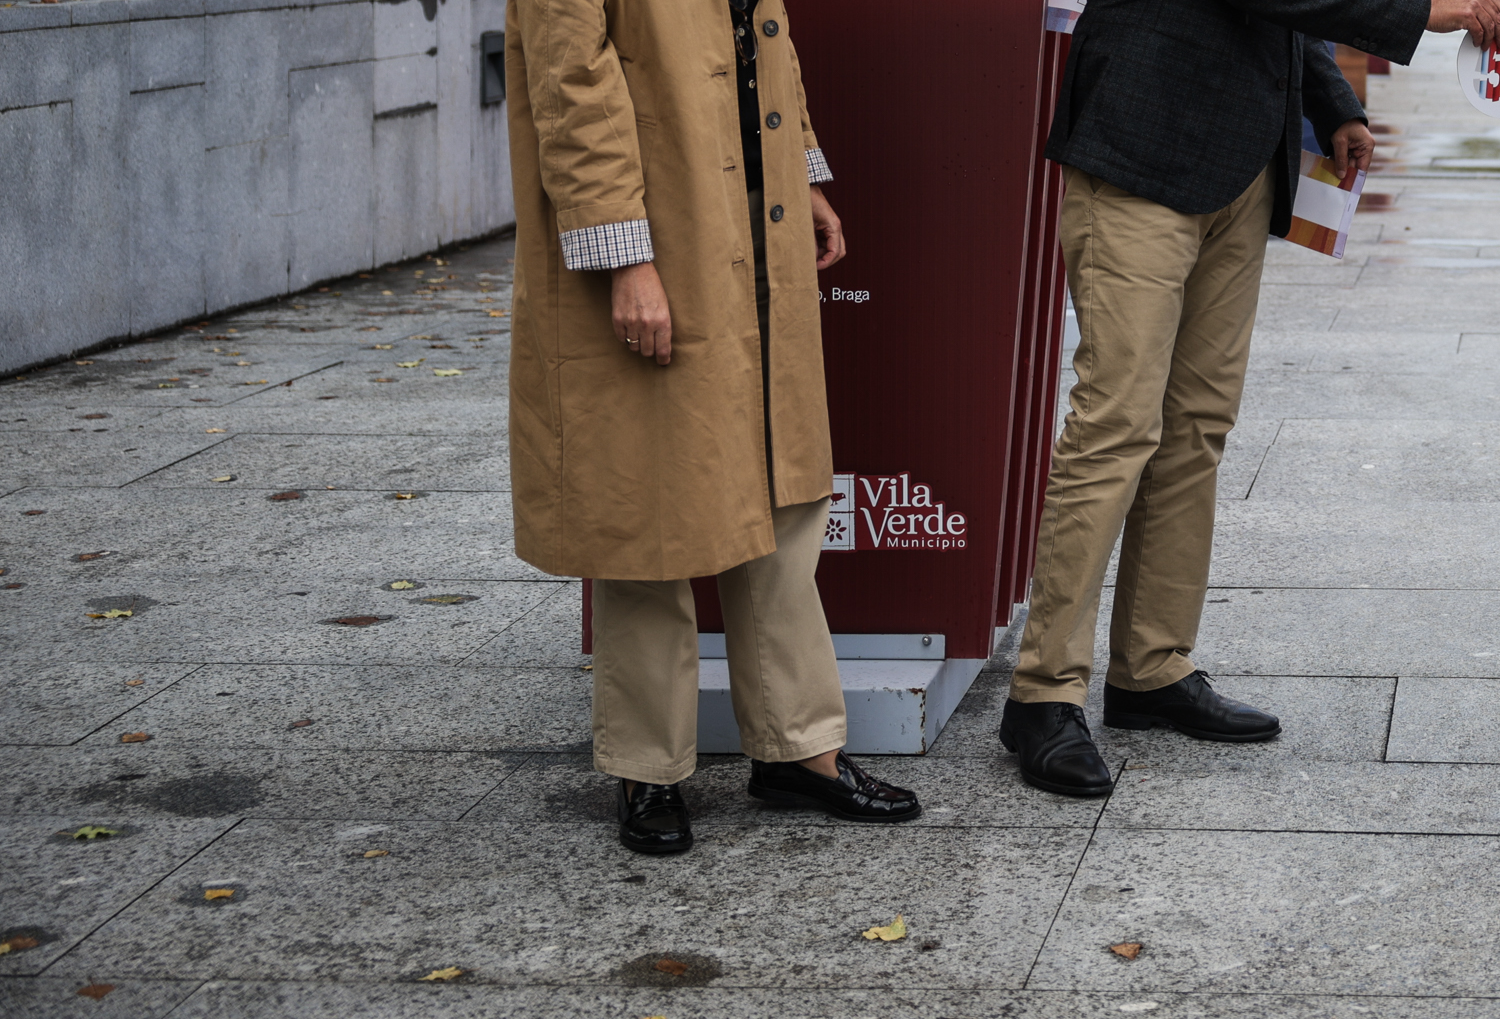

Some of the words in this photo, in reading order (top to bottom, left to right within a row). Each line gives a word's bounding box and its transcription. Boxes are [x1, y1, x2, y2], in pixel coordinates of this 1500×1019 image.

[832, 287, 870, 304] Braga
[859, 474, 932, 507] Vila
[860, 503, 966, 548] Verde
[887, 536, 966, 550] Município
